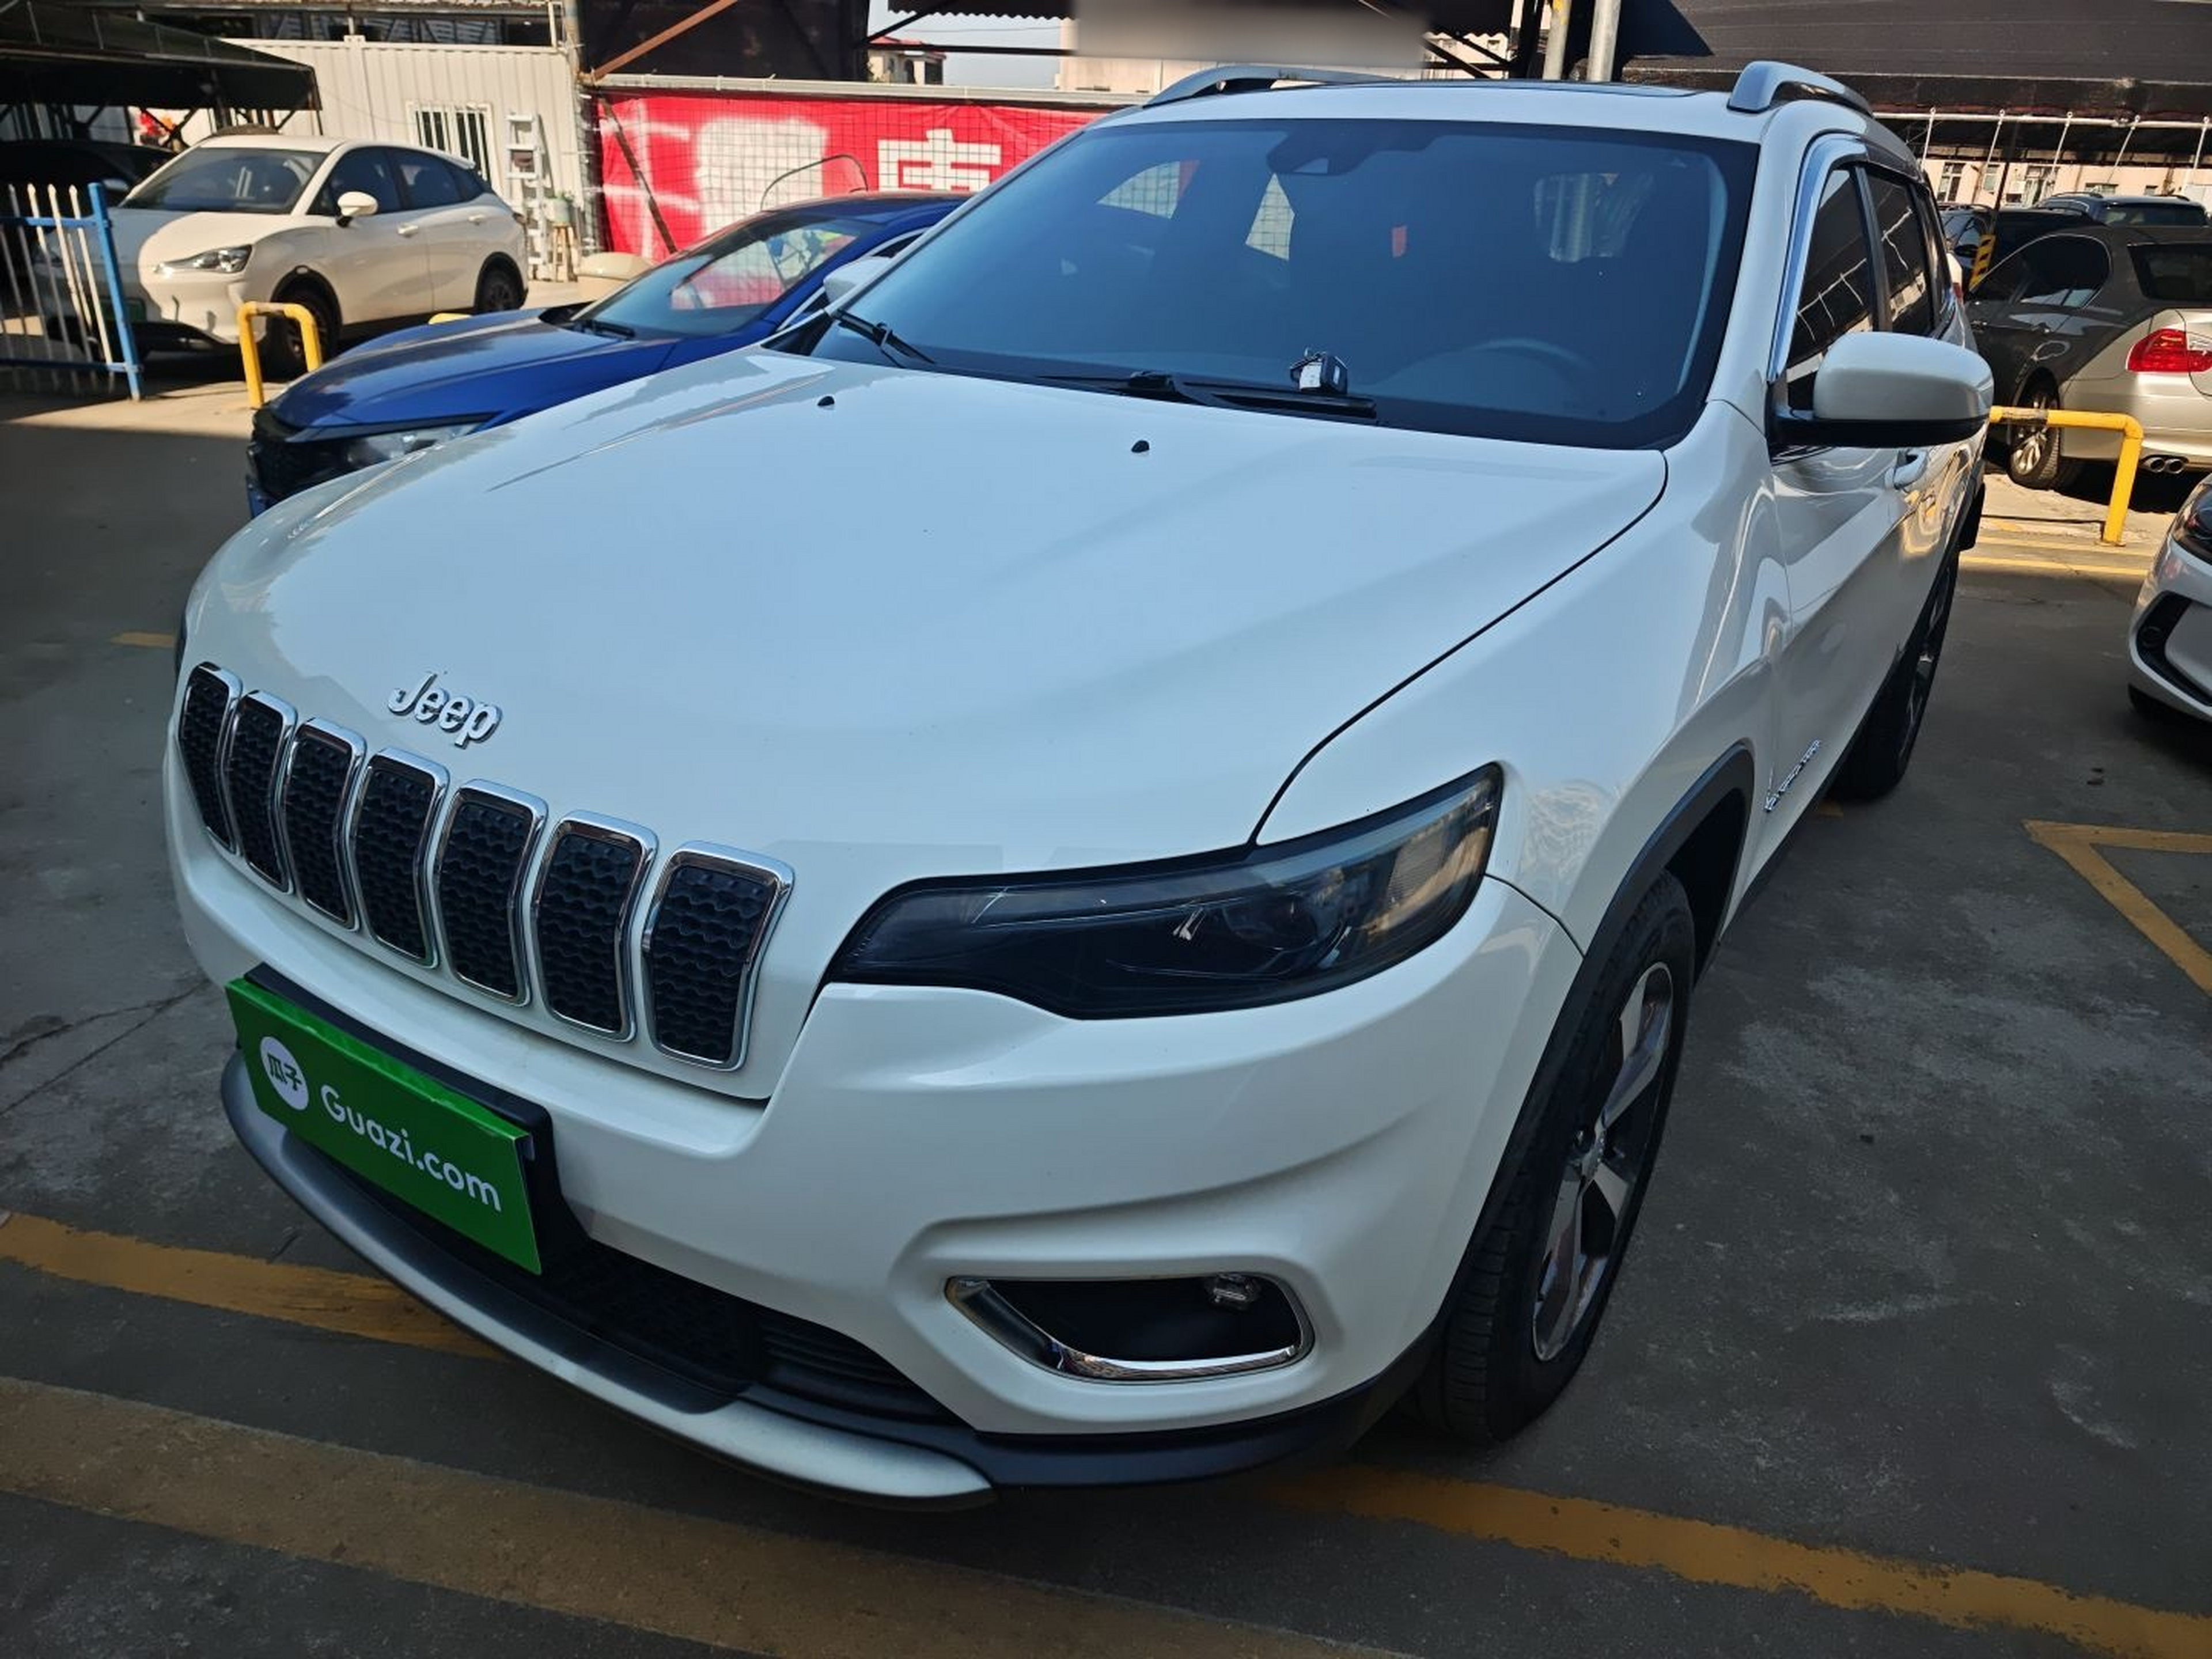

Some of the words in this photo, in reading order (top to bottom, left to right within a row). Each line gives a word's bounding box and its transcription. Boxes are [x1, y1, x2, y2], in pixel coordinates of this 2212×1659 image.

[387, 672, 503, 749] Jeep
[267, 1052, 303, 1092] 瓜子
[320, 1084, 502, 1213] Guazi.com
